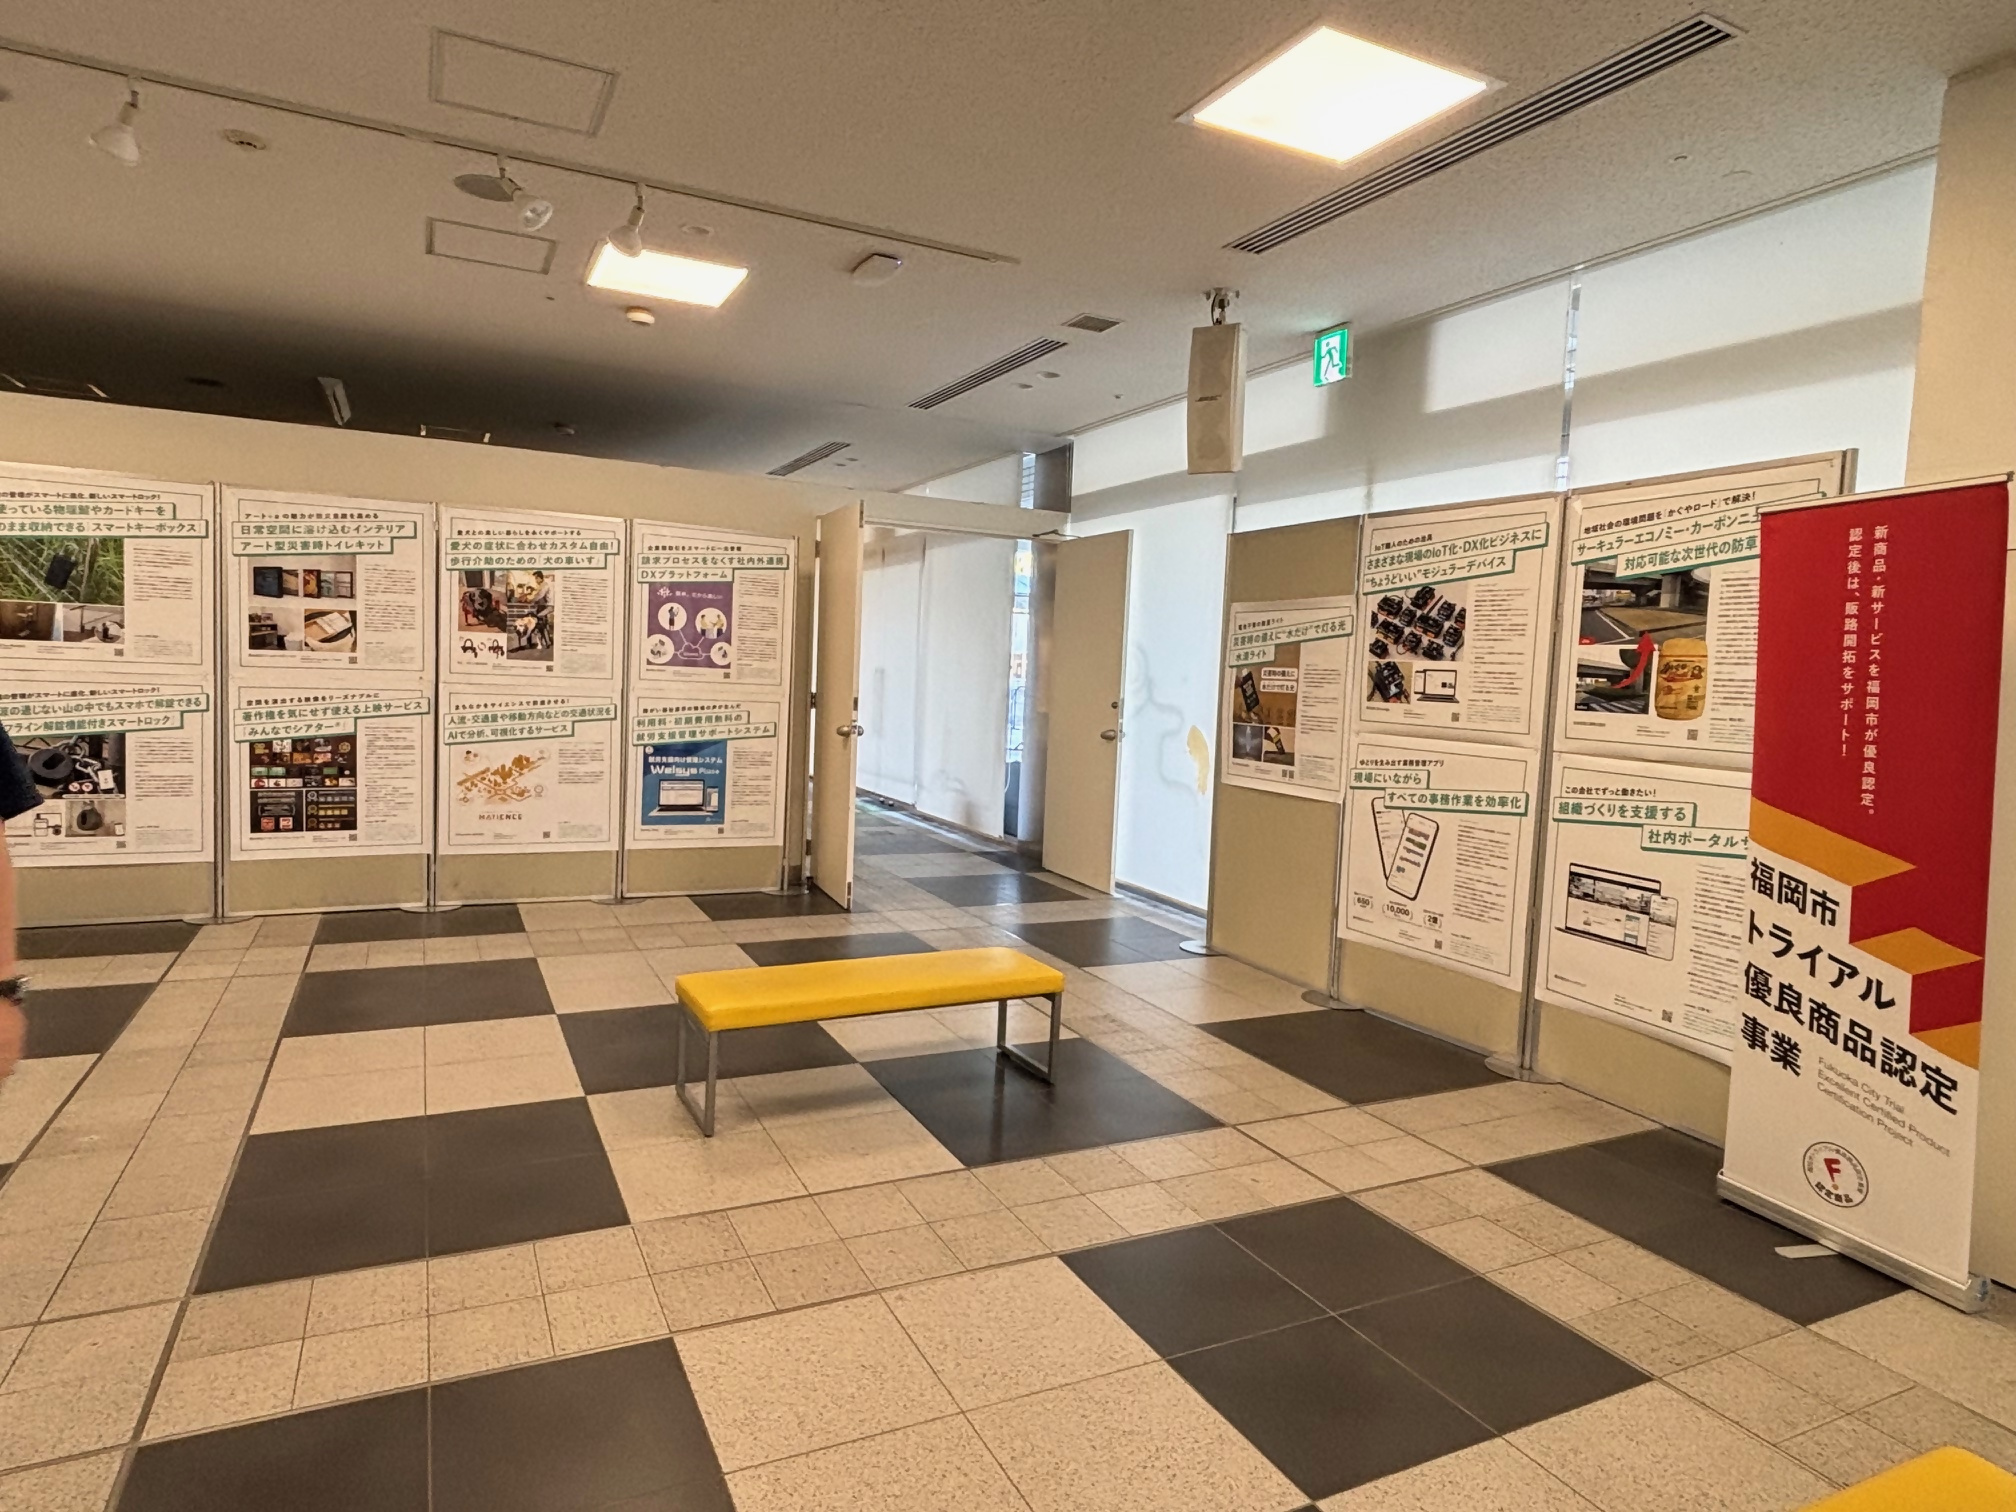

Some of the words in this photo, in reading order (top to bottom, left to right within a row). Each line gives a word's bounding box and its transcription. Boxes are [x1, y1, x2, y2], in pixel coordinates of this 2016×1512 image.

[0, 491, 160, 501] の管理がスマートに進化、新しいスマートロック!
[240, 524, 406, 535] 日常空間に溶け込むインテリア
[240, 540, 384, 551] アート型災害時トイレキット
[1624, 533, 1759, 571] 対応可能な次世代の防草
[641, 554, 784, 566] 請求プロセスをなくす社内外連携
[641, 570, 728, 580] DXプラットフォーム
[0, 687, 160, 700] の管理がスマートに進化、新しいスマートロック!
[241, 701, 423, 722] 著作権を気にせず使える上映サービス
[447, 725, 568, 741] AIで分析、可視化するサービス
[636, 726, 771, 742] 就労支援管理サポートシステム
[1353, 771, 1422, 786] 現場にいながら
[1387, 791, 1522, 809] すべての事務作業を効率化
[1557, 801, 1687, 822] 組織づくりを支援する
[1750, 857, 1840, 928] 福岡市
[1748, 909, 1897, 1011] トライアル
[1741, 1011, 1802, 1078] 事業
[1744, 960, 1959, 1116] 優良商品認定
[1818, 1056, 1860, 1089] Fukuoka
[1861, 1082, 1881, 1101] City
[1884, 1094, 1905, 1115] Trial
[1816, 1081, 1875, 1123] Certification
[1876, 1117, 1914, 1148] Project
[1817, 1068, 1860, 1101] Excellent
[1862, 1096, 1906, 1129] Certified
[1908, 1123, 1951, 1158] Product
